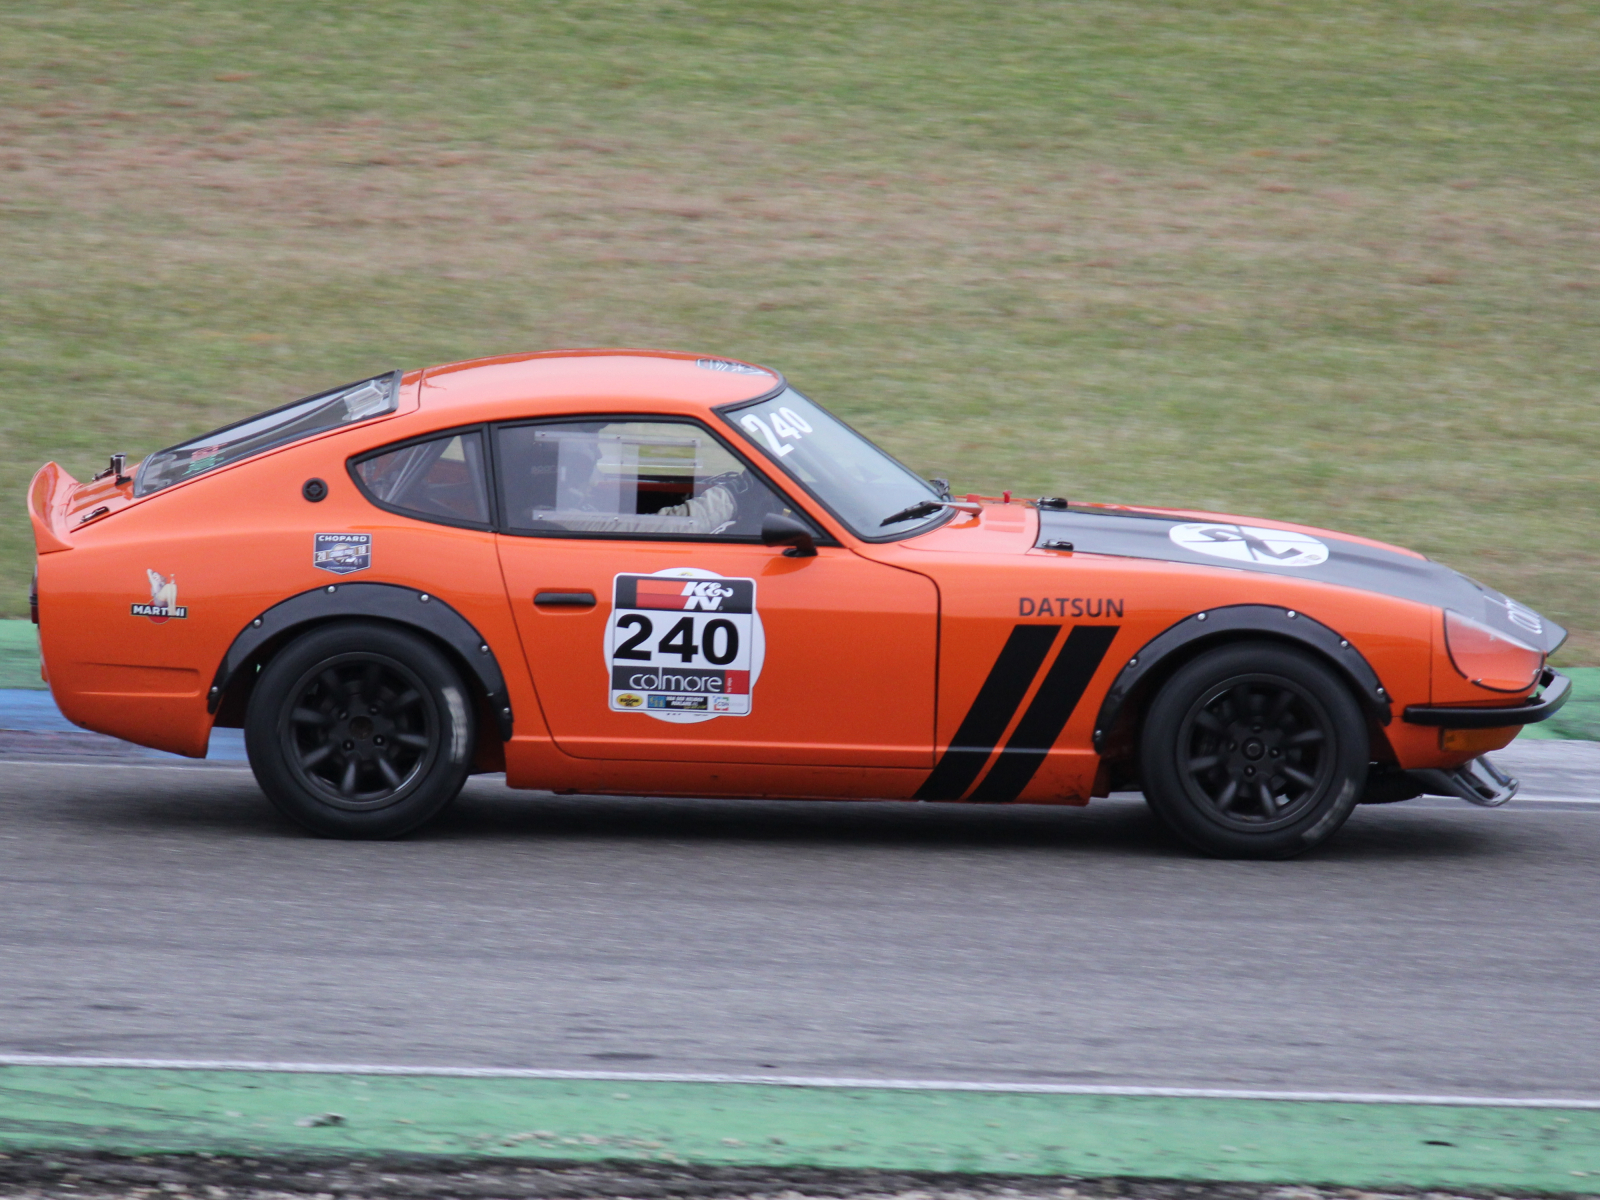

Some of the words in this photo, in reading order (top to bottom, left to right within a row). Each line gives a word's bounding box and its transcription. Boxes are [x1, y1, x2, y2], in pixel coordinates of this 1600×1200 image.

[740, 407, 813, 457] 240
[133, 605, 185, 617] MARTI
[1019, 597, 1124, 618] DATSUN
[613, 613, 739, 666] 240
[629, 667, 722, 692] colmore
